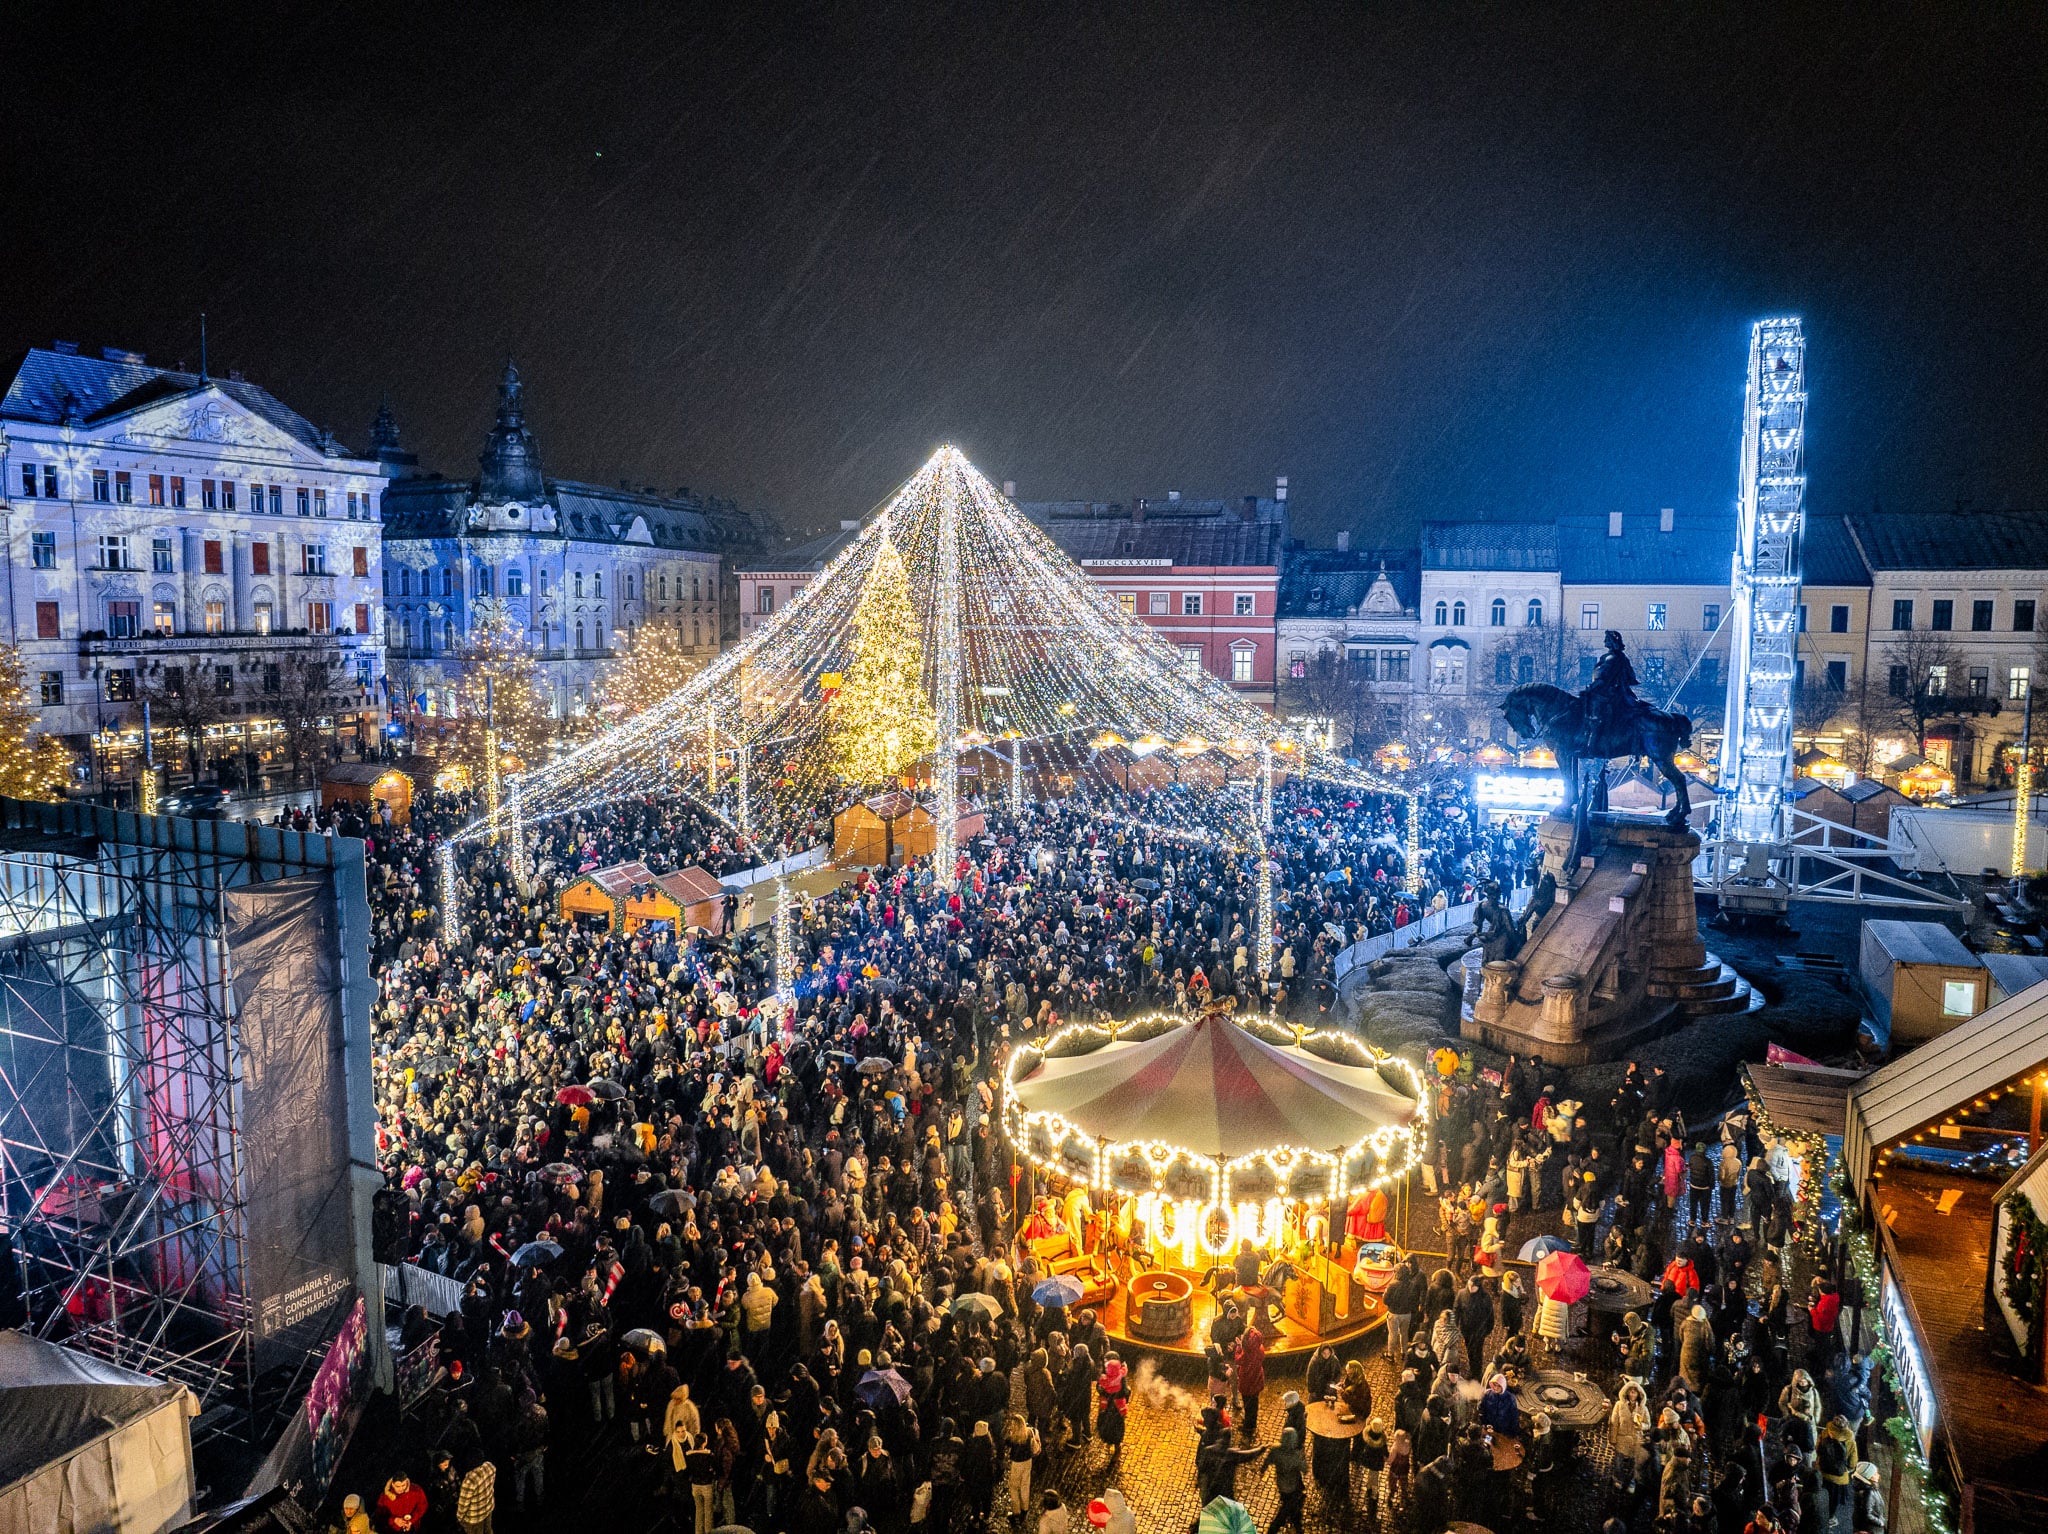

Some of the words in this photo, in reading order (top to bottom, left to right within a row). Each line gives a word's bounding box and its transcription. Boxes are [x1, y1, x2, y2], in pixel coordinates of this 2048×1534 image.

[284, 1278, 322, 1302] PRIMĂRIA
[285, 1289, 326, 1315] CONSILIUL
[327, 1277, 351, 1294] LOCAL
[285, 1295, 339, 1327] CLUJ-NAPOCA
